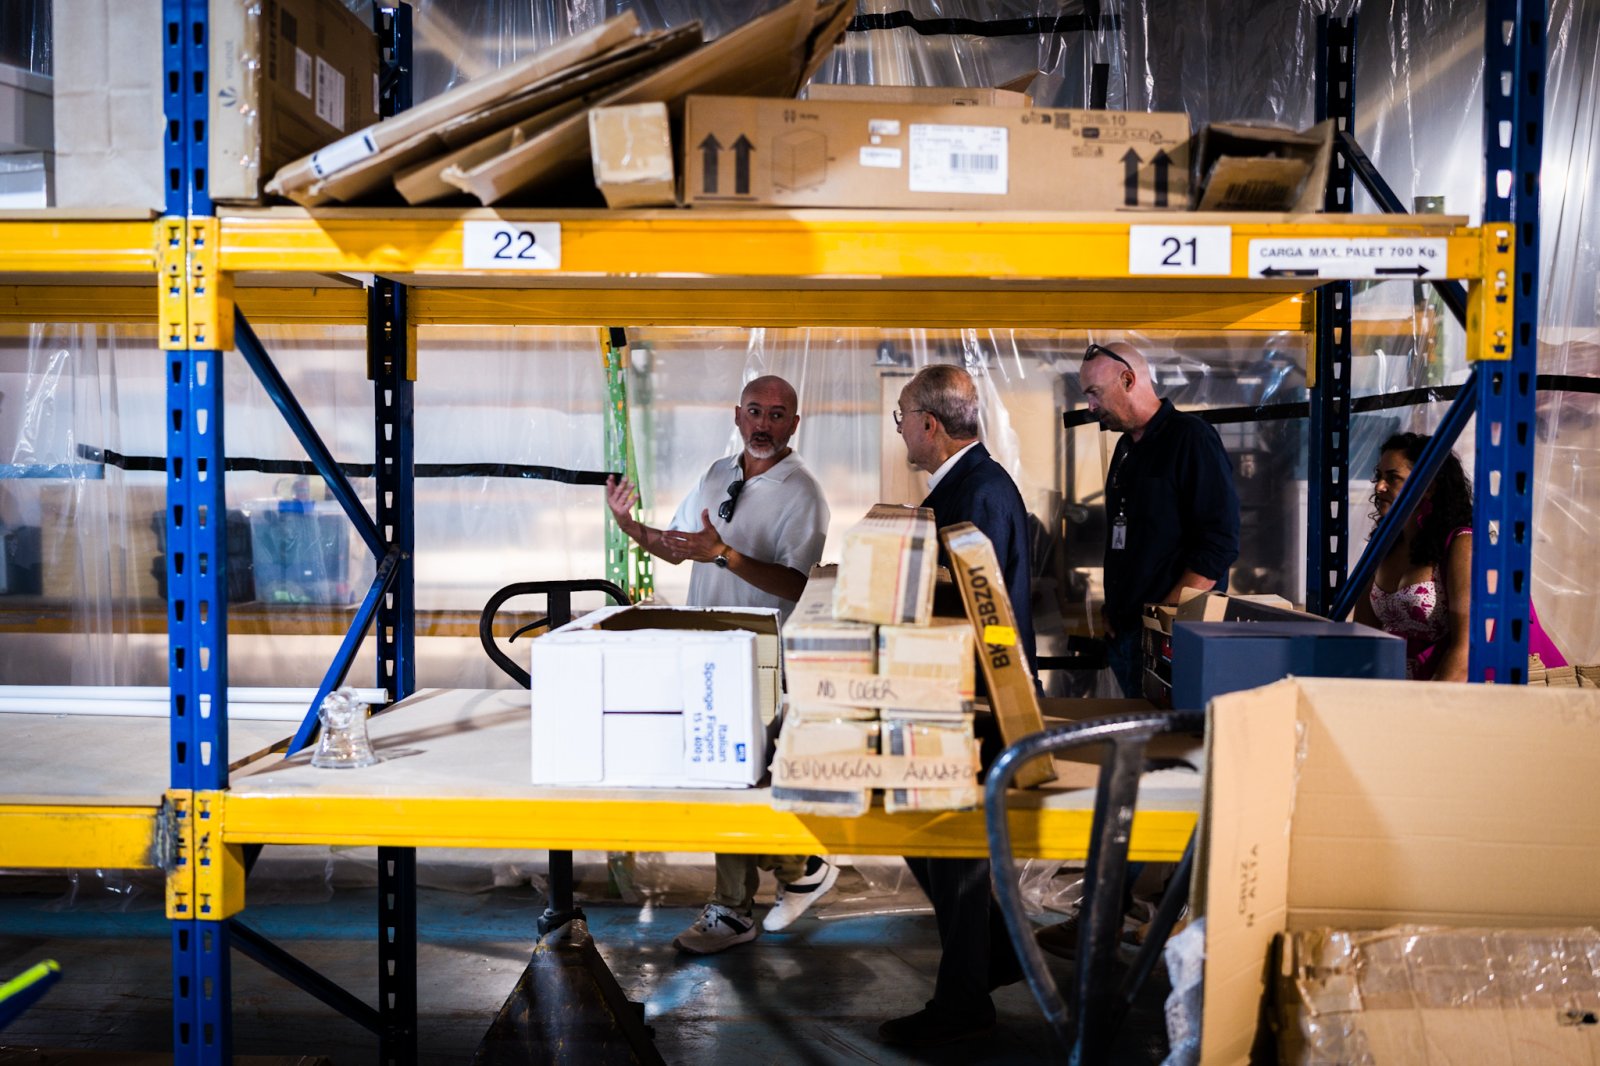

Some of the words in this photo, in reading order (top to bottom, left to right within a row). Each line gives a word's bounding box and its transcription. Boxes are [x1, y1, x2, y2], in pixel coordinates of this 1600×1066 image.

[493, 231, 536, 259] 22
[1161, 237, 1197, 266] 21
[1259, 247, 1303, 258] CARGA
[1309, 247, 1340, 258] MAX.
[1345, 247, 1383, 258] PALET
[1390, 247, 1413, 257] 700
[1418, 247, 1438, 259] Kg.
[968, 566, 1011, 669] BK5BZ01
[703, 662, 716, 711] Sponge
[816, 678, 836, 698] NO
[848, 677, 898, 700] COGER
[704, 715, 716, 763] Fingers
[719, 724, 728, 763] Italian
